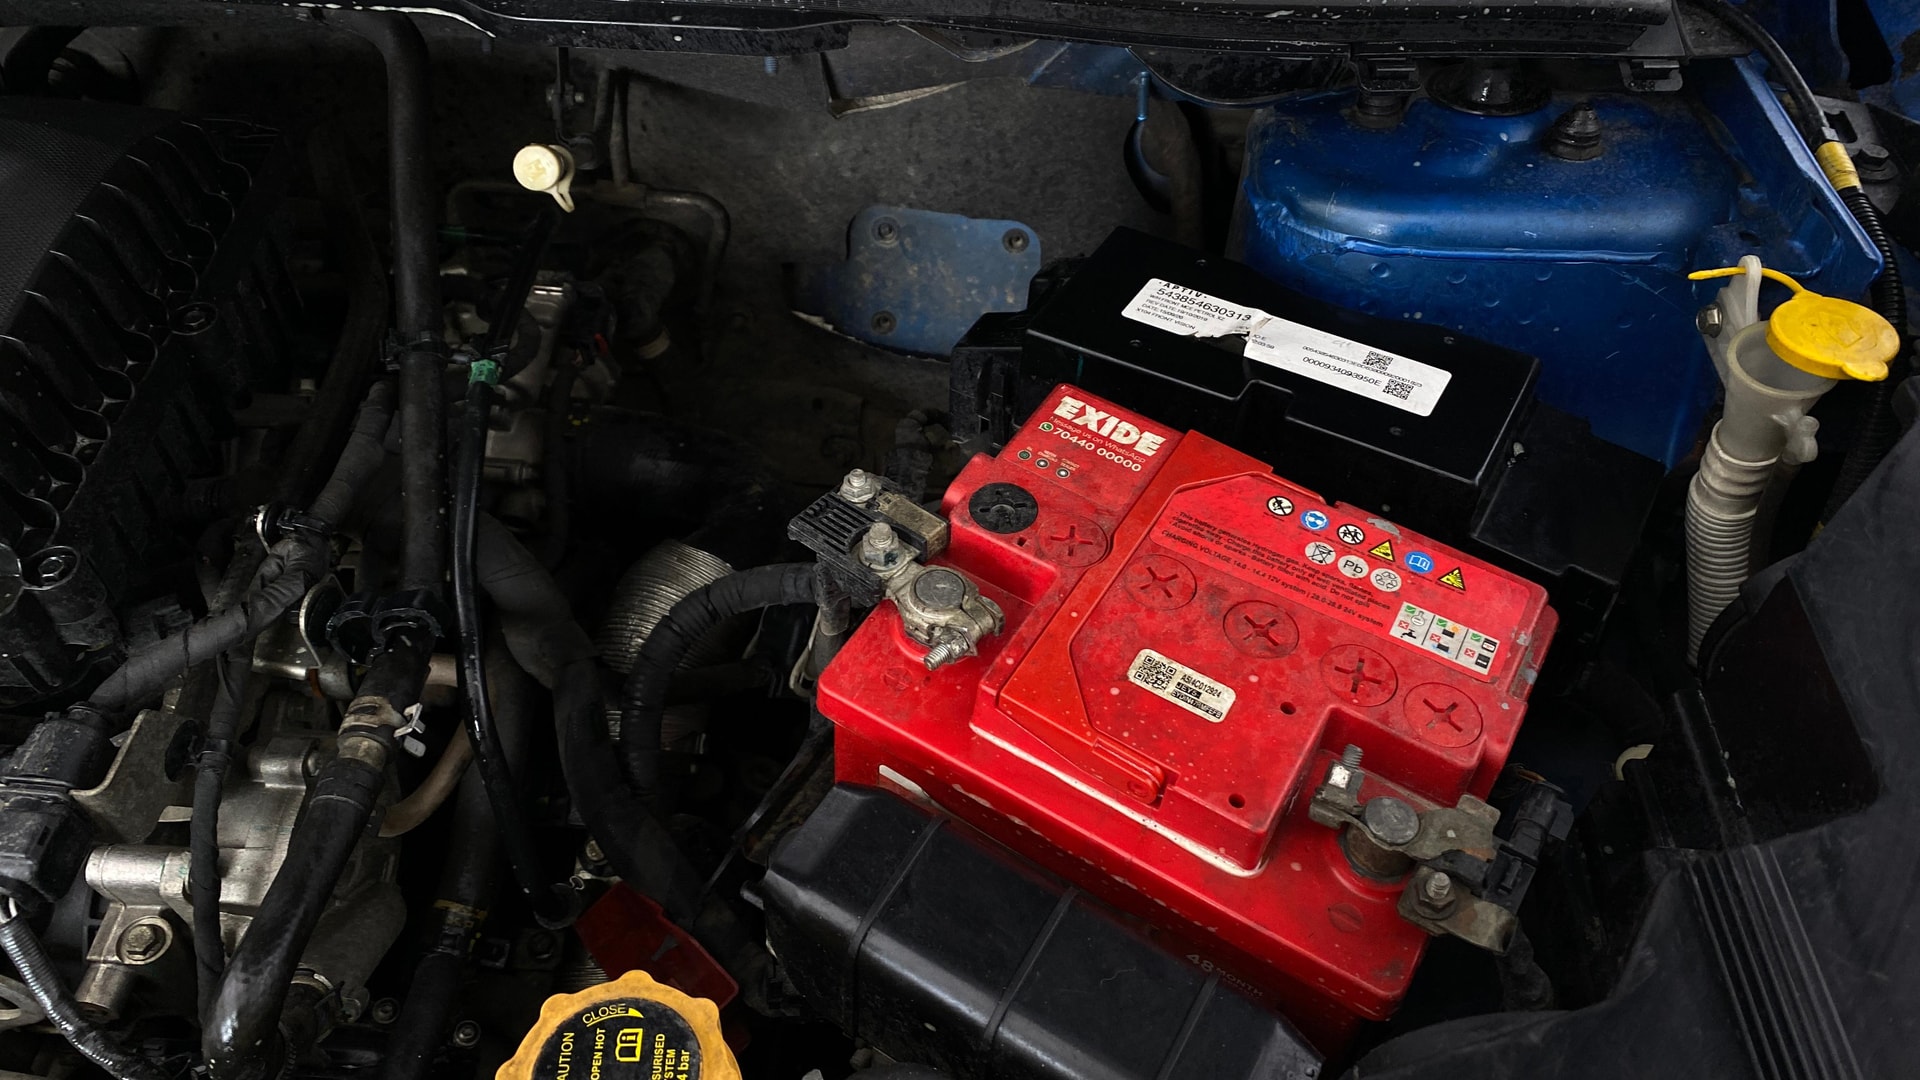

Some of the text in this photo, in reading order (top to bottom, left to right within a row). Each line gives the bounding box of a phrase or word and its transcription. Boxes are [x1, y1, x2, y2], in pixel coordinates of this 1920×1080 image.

[1163, 283, 1202, 297] APTIV
[1053, 395, 1167, 456] EXIDE
[1053, 428, 1141, 471] 70440 00000
[1105, 441, 1146, 463] WhatsApp
[1200, 546, 1232, 563] VOLTAGE
[1343, 559, 1364, 574] Pb
[1186, 954, 1214, 972] 48
[1215, 967, 1263, 996] MONTH
[582, 1003, 627, 1025] CLOSE
[590, 1028, 606, 1080] OPEN HOT
[664, 1049, 676, 1080] STEM
[678, 1050, 691, 1071] bar
